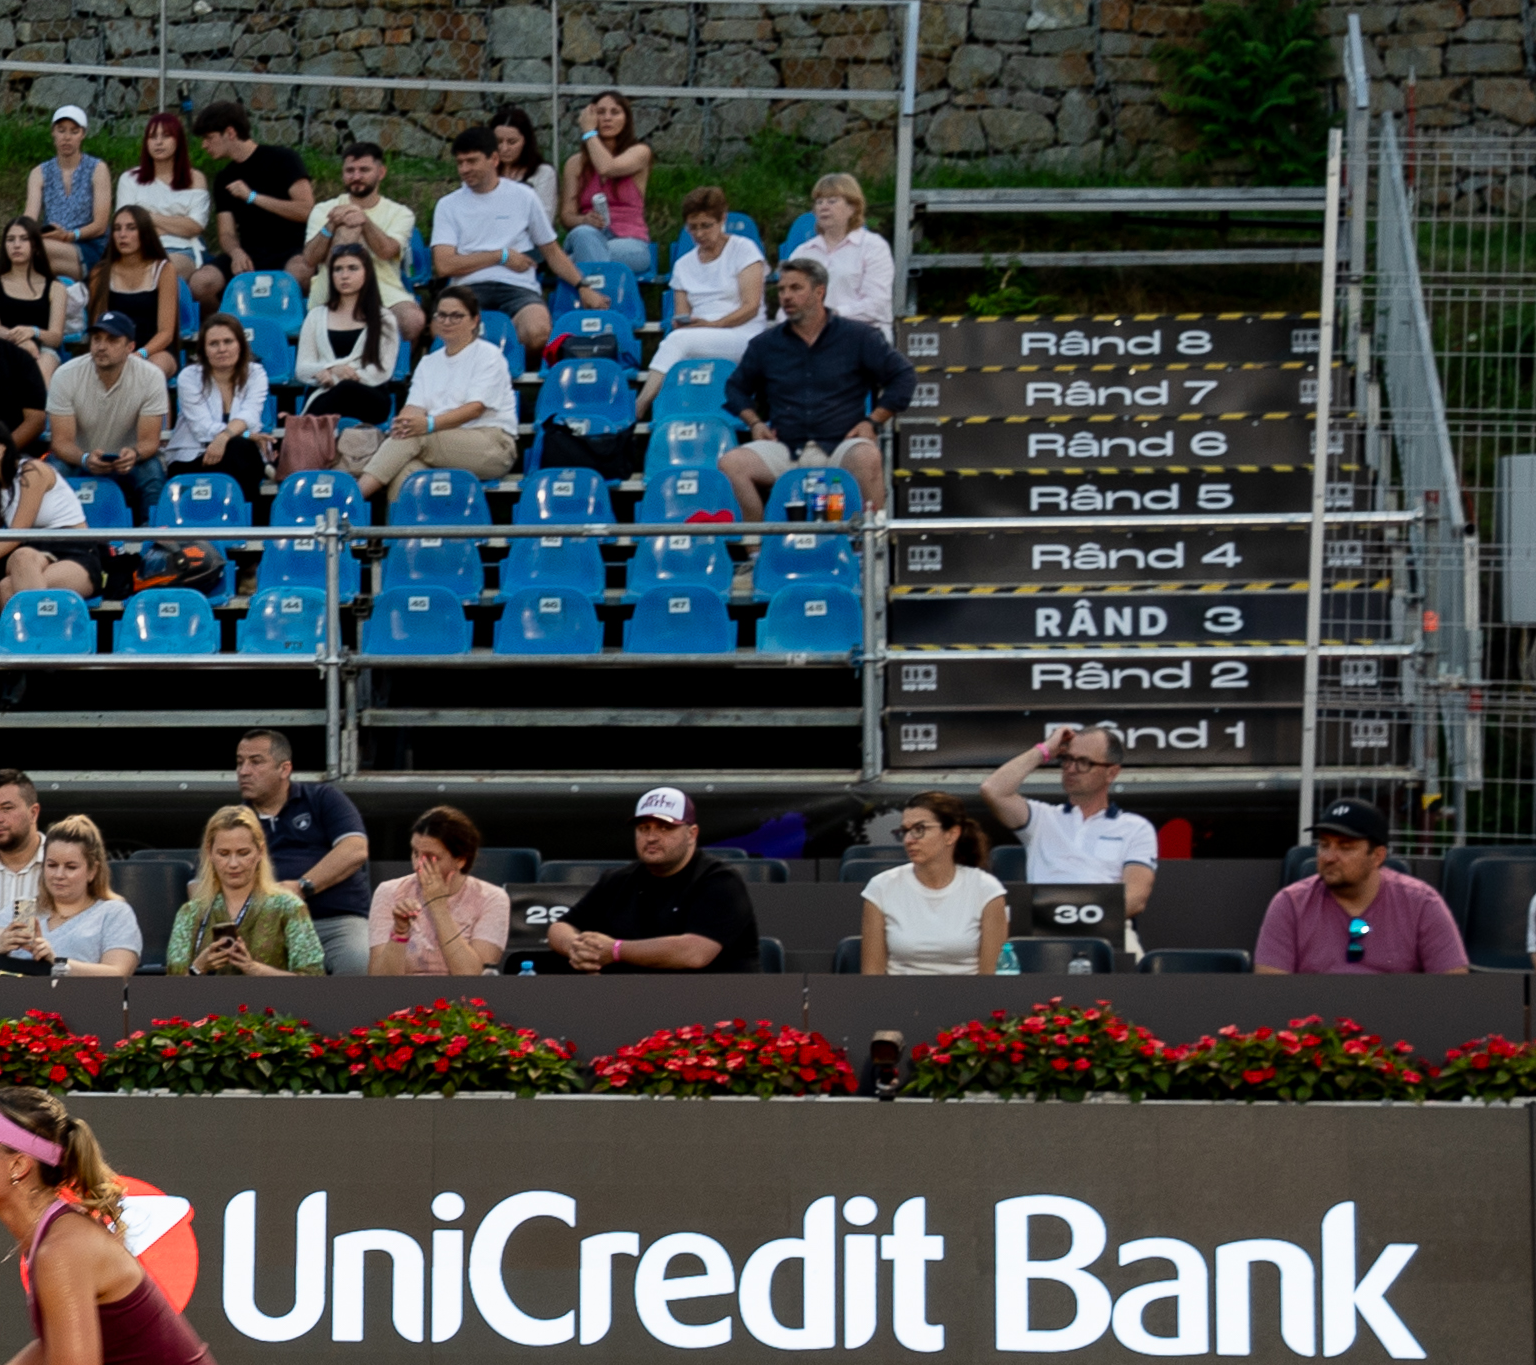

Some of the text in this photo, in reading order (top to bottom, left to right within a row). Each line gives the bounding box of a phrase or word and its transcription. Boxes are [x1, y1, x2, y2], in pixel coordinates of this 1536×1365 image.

[1021, 328, 1213, 356] Rând 8
[1026, 379, 1218, 407] Rând 7
[1028, 430, 1228, 458] Rând 6
[1030, 483, 1234, 512] Rând 5
[1031, 541, 1242, 570] Rând 4
[40, 604, 55, 612] 42
[1034, 599, 1244, 637] RÂND 3
[1031, 662, 1250, 691] Rând 2
[1225, 721, 1245, 748] 1
[1053, 904, 1104, 924] 30
[222, 1190, 1427, 1360] UniCredit Bank
